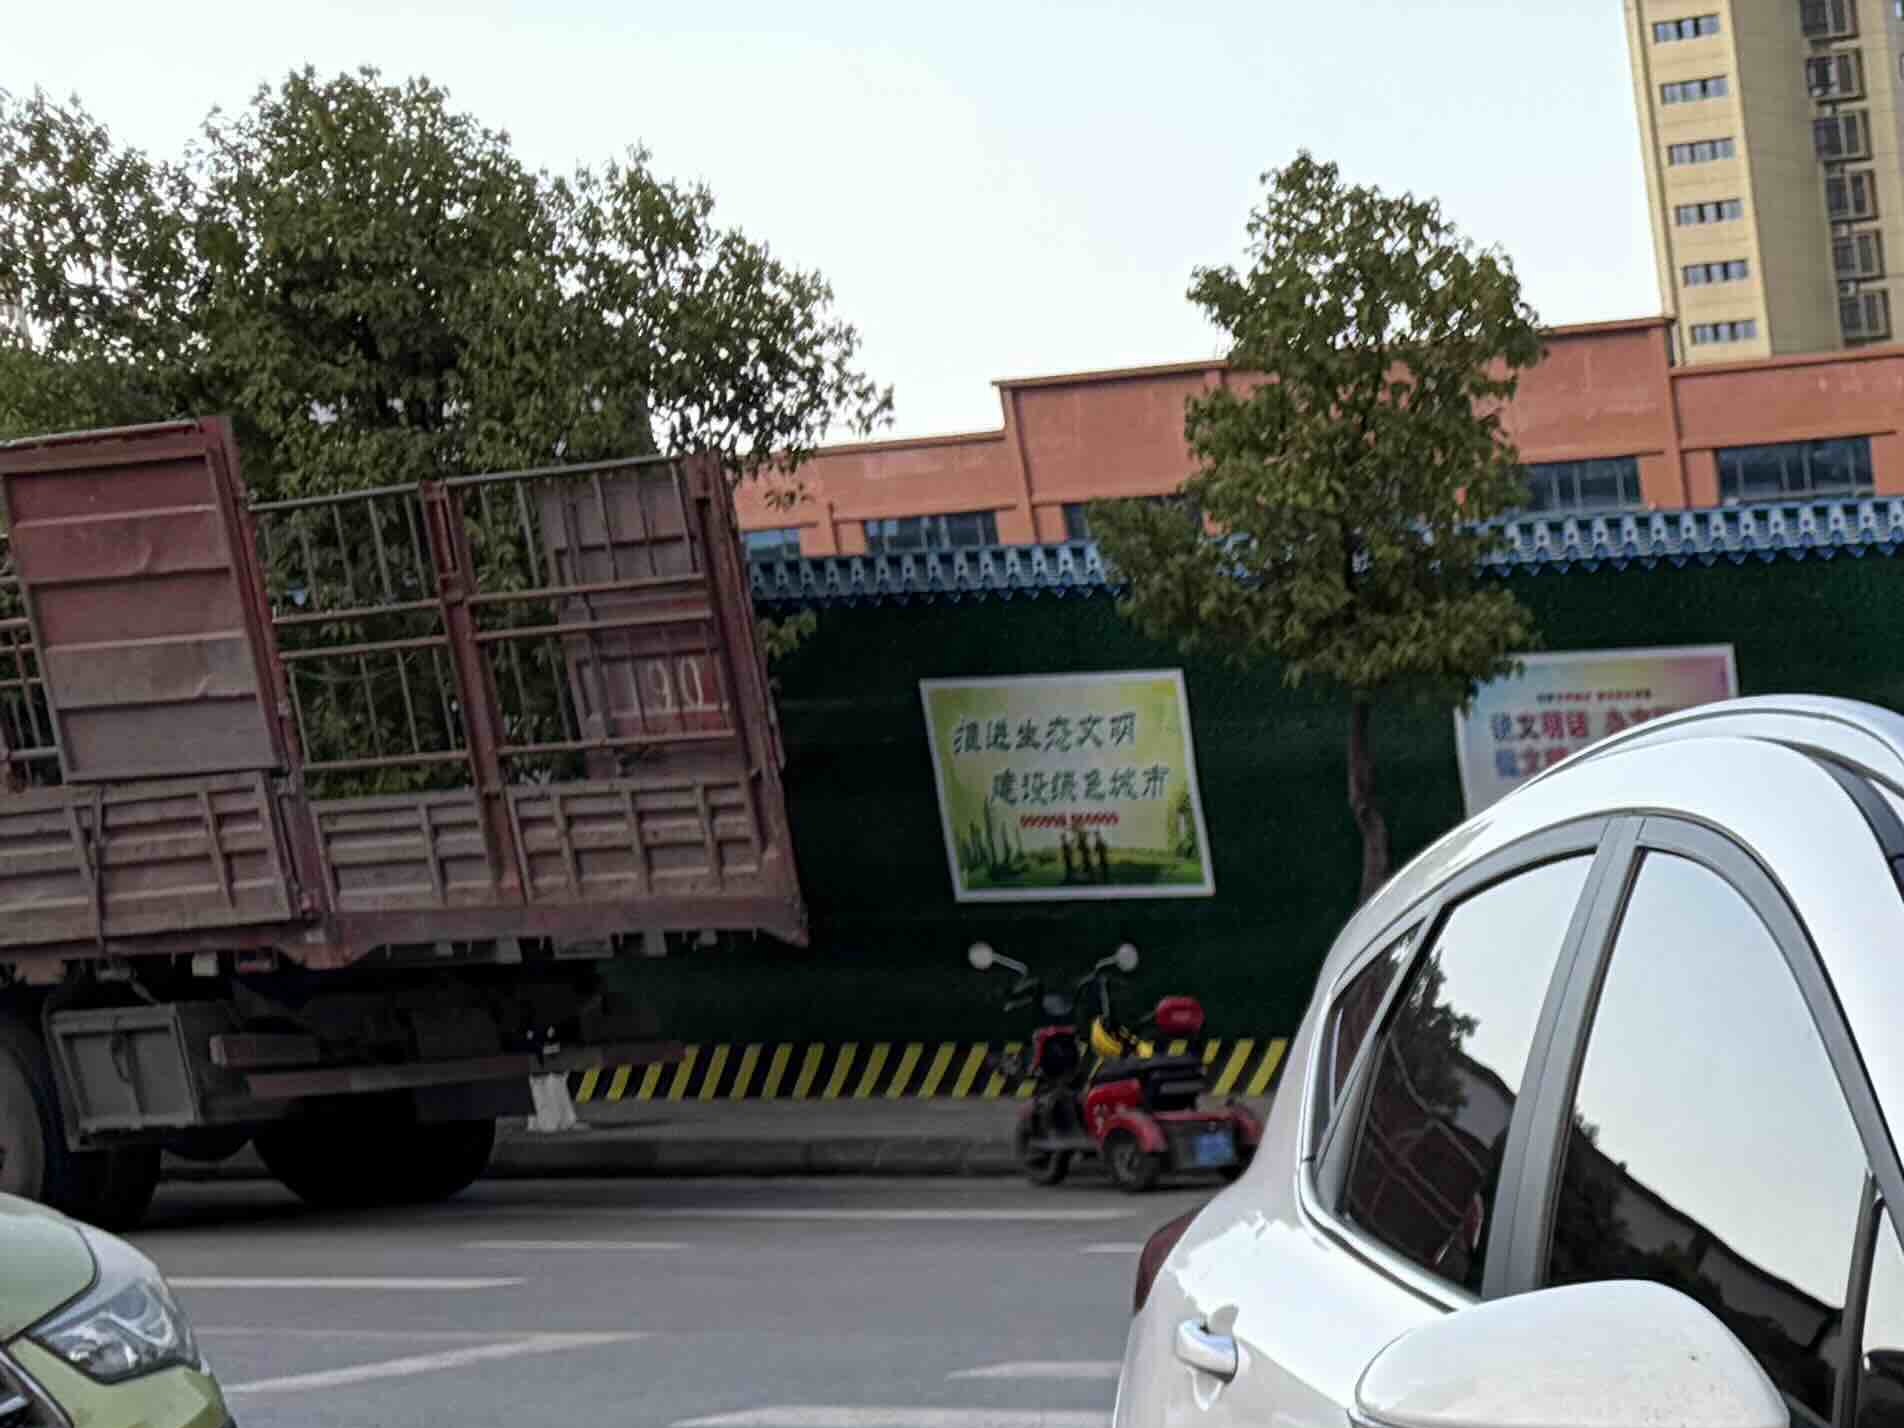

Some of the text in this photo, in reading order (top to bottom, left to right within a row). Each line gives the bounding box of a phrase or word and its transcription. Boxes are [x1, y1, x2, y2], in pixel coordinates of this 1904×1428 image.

[952, 710, 1137, 755] 推进生态文明
[990, 762, 1171, 807] 建设绿色城市
